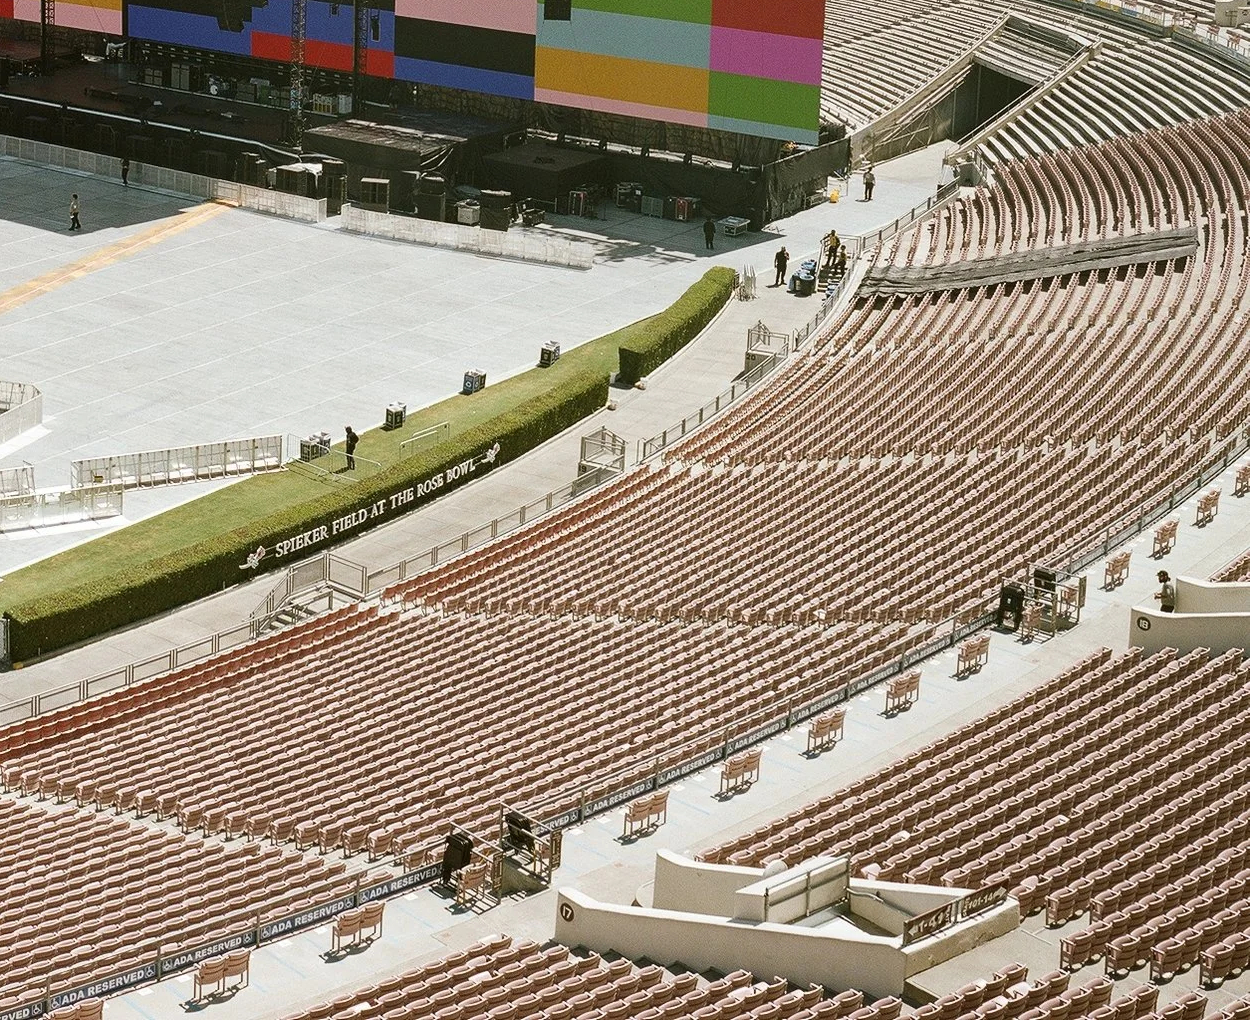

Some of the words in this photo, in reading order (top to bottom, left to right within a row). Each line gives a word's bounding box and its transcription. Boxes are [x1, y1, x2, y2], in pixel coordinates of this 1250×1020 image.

[275, 525, 329, 558] SPIEKER
[332, 508, 368, 535] FIELD
[370, 499, 387, 519] AT
[390, 487, 415, 509] THE
[416, 473, 444, 498] ROSE
[446, 459, 476, 483] BOWL
[867, 666, 894, 684] RESERVED
[797, 707, 810, 720] ADA
[810, 693, 839, 714] RESERVED
[734, 737, 749, 751] ADA
[748, 723, 780, 744] RESERVED
[665, 769, 681, 781] ADA
[681, 753, 715, 775] RESERVED
[591, 800, 609, 812] ADA
[608, 784, 646, 808] RESERVED
[369, 886, 389, 899] ADA
[390, 867, 438, 891] RESERVED
[271, 922, 292, 934] ADA
[294, 902, 344, 927] RESERVED
[562, 905, 572, 919] 17
[173, 954, 193, 967] ADA
[194, 936, 242, 961] RESERVED
[61, 991, 85, 1006] ADA
[87, 970, 145, 996] RESERVED
